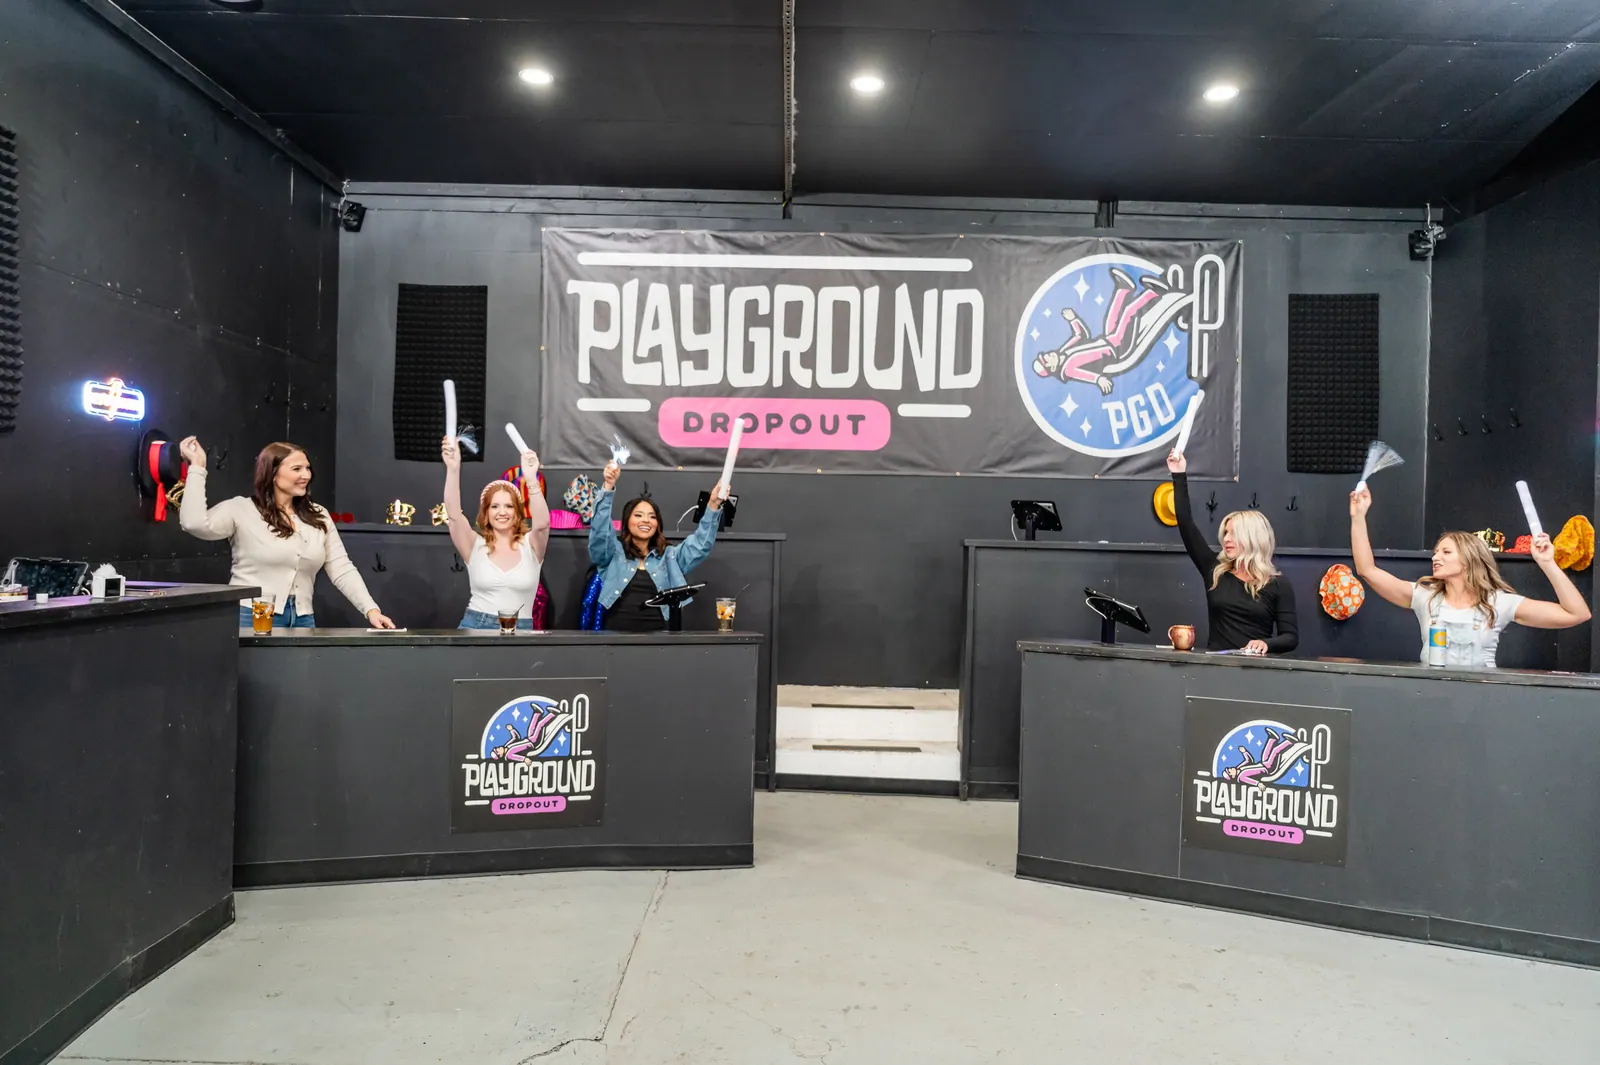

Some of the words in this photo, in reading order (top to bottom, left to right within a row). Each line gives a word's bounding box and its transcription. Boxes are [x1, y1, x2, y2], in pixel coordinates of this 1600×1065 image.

[567, 278, 984, 392] PLAYGROUND
[683, 411, 866, 435] DROPOUT
[1102, 382, 1175, 444] PGD
[462, 759, 596, 797] PLAYGROUND
[499, 800, 559, 810] DROPOUT
[1193, 779, 1338, 828] PLAYGROUND
[1231, 824, 1295, 839] DROPOUT
